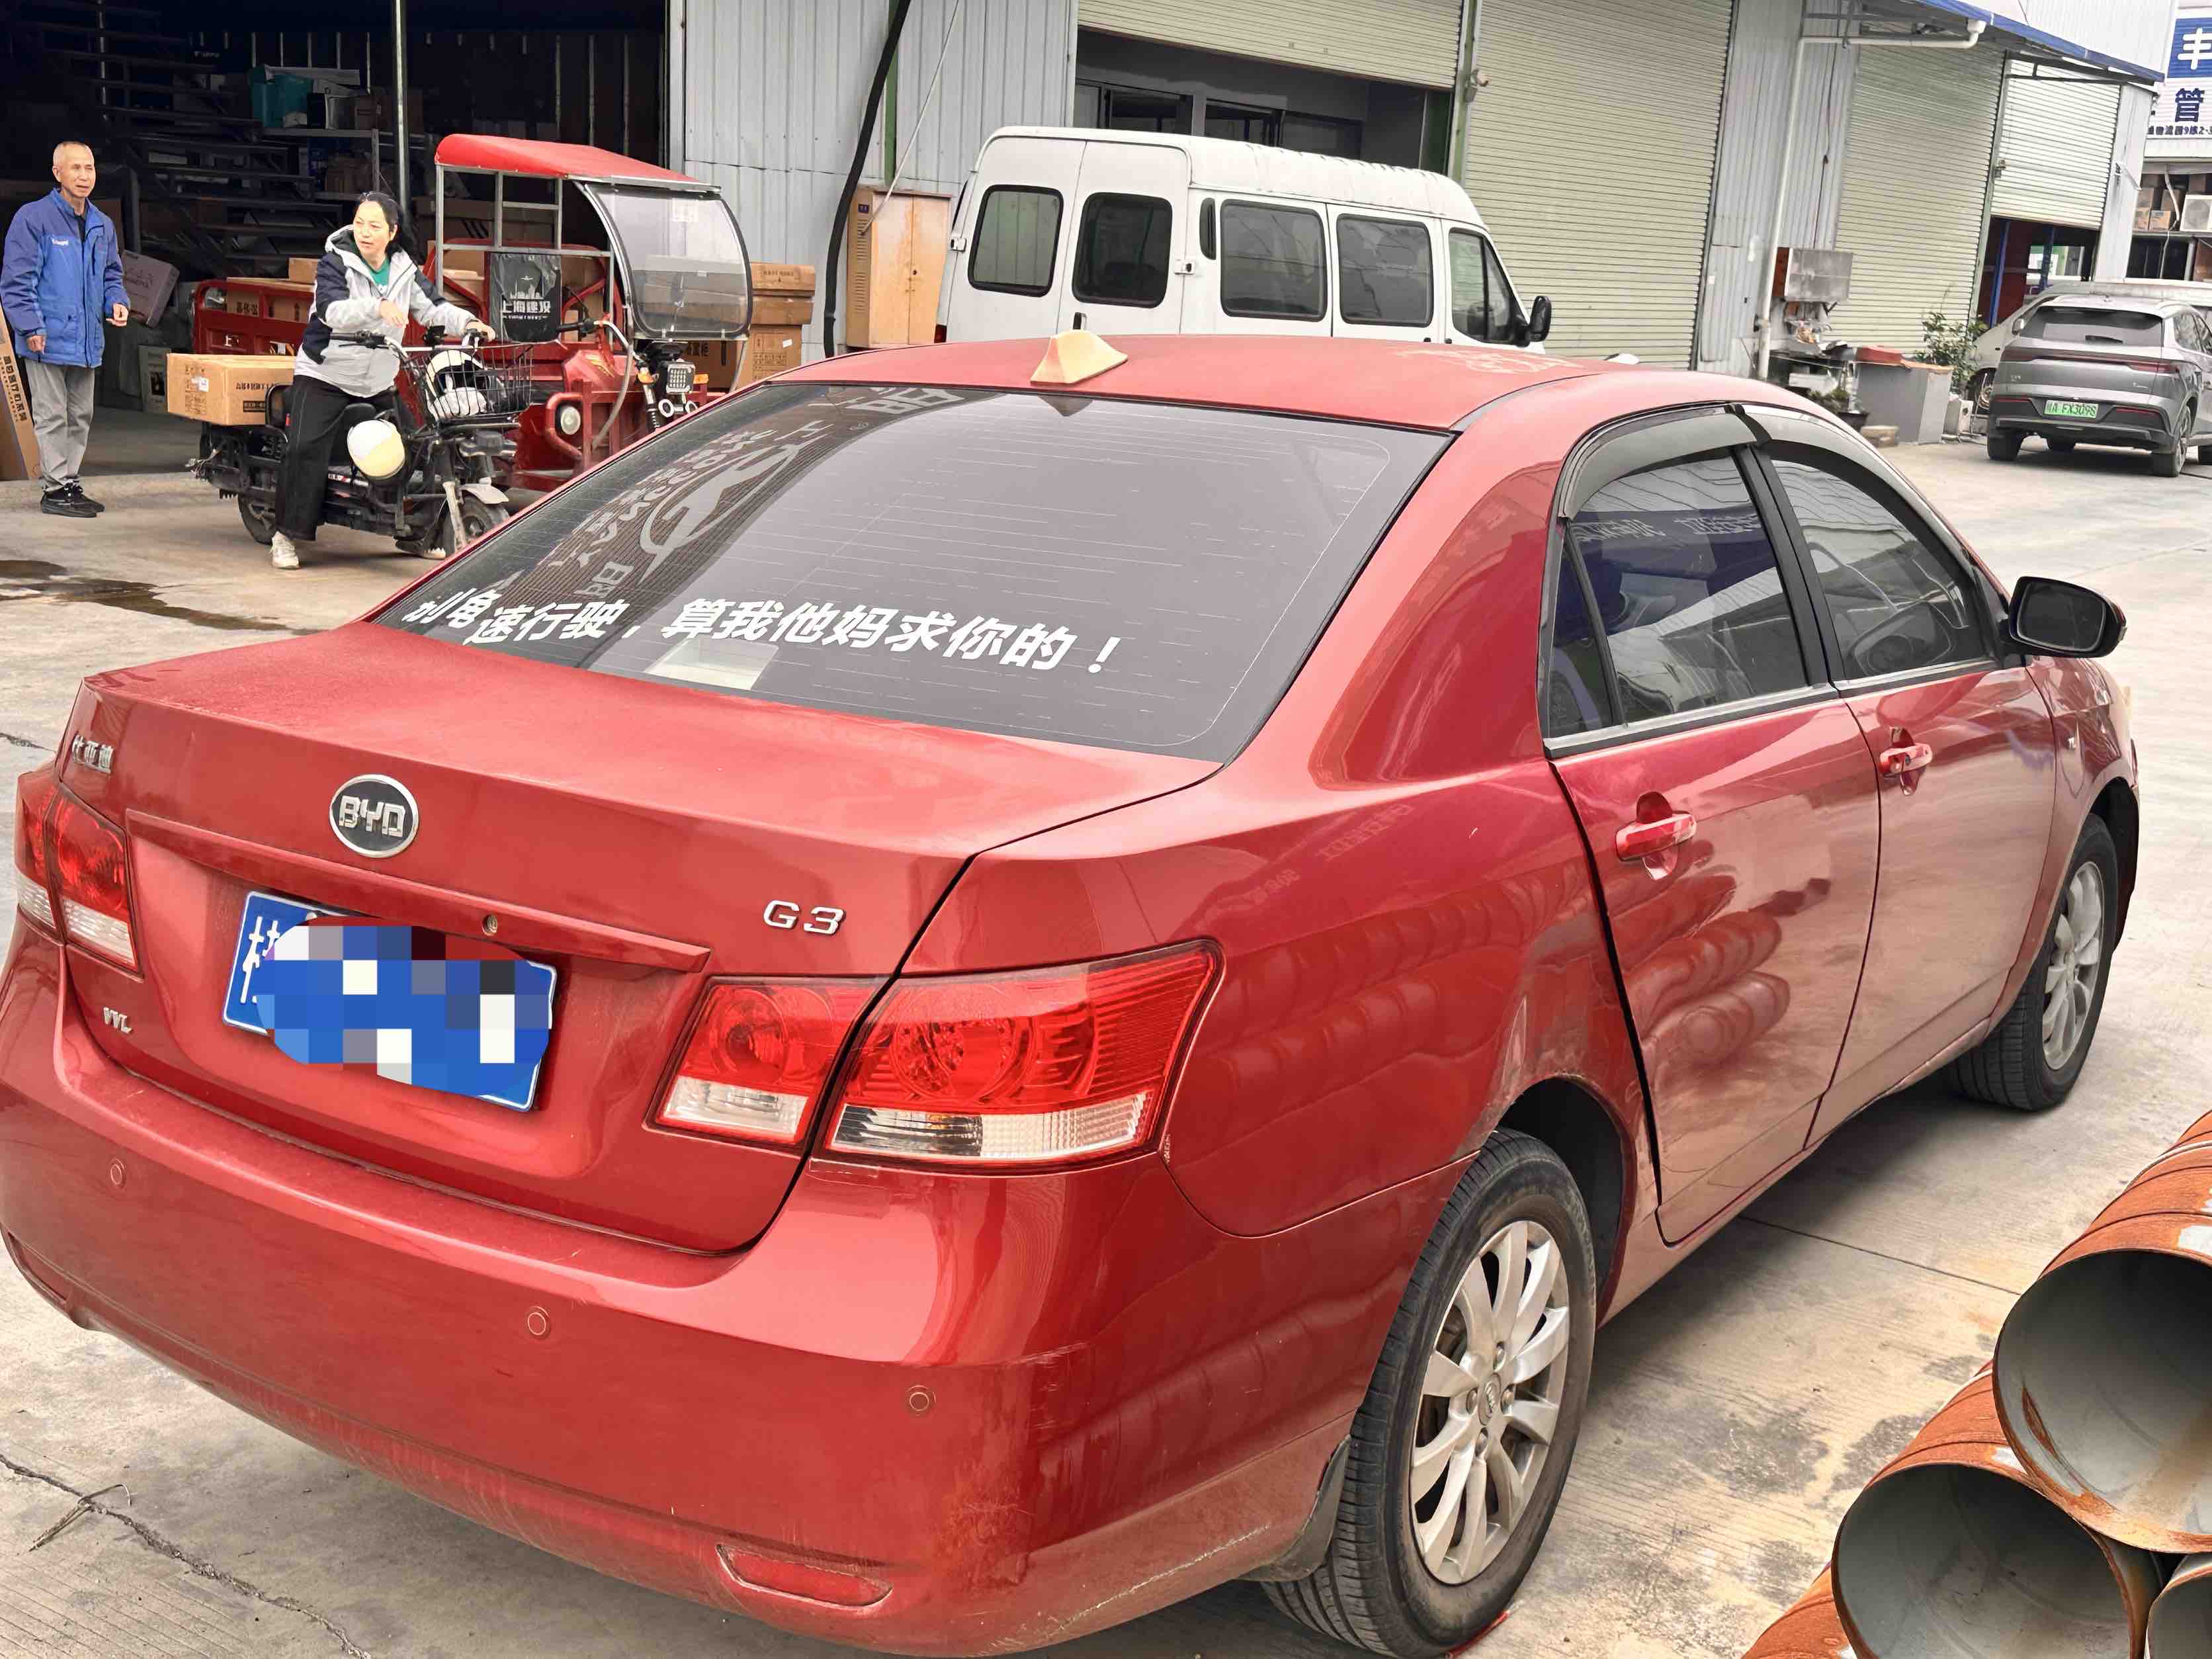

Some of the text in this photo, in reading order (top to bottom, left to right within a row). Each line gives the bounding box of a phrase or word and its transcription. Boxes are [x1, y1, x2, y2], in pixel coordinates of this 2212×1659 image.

[339, 795, 405, 837] BYD
[763, 900, 845, 935] G3
[103, 1007, 132, 1034] VVL
